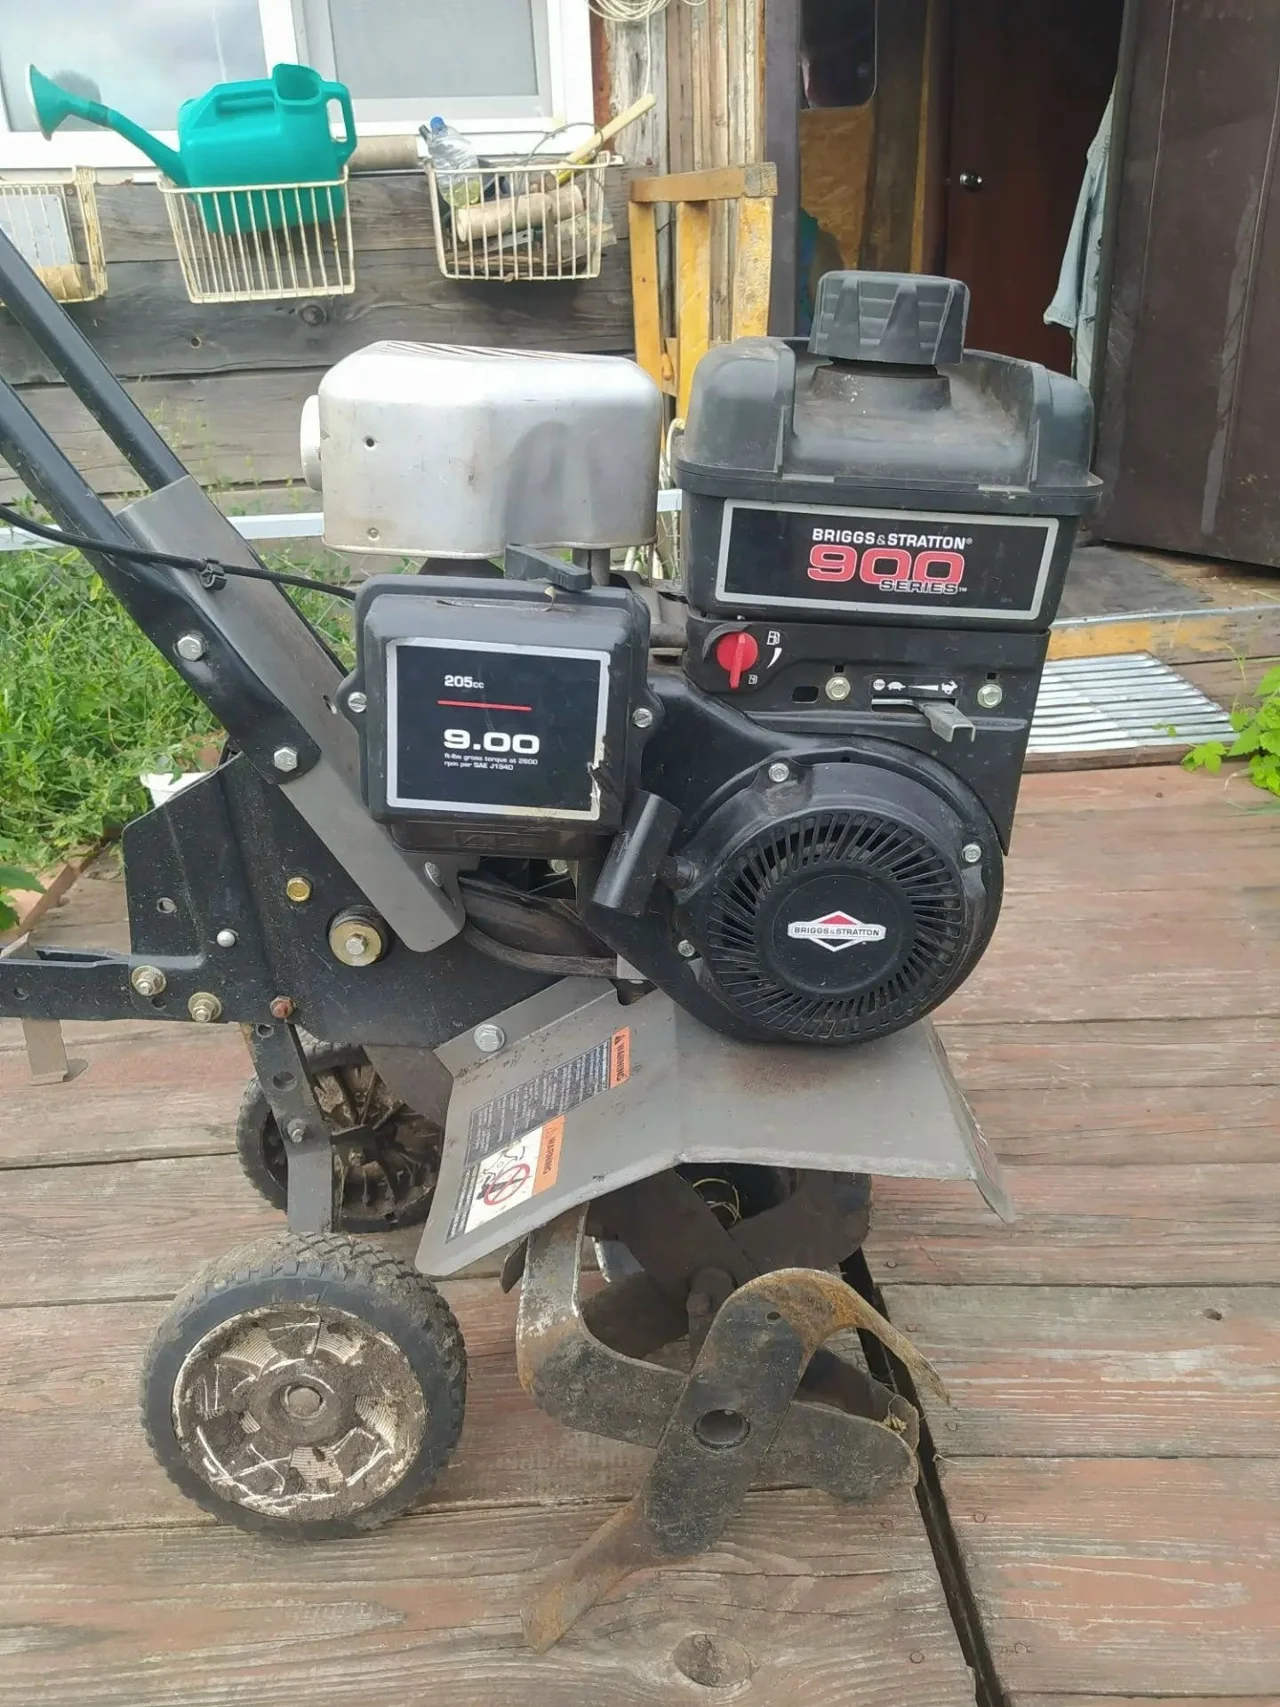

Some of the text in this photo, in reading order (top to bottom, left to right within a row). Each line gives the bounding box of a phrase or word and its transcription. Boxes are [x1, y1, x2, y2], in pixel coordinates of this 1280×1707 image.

[807, 544, 965, 585] 900
[444, 674, 485, 689] 205cc
[443, 729, 540, 754] 9.00
[460, 761, 473, 769] per
[473, 761, 488, 769] SAE
[463, 754, 483, 763] gross
[484, 755, 508, 764] torque
[616, 1044, 628, 1083] WARNING
[542, 1135, 556, 1176] WARNING
